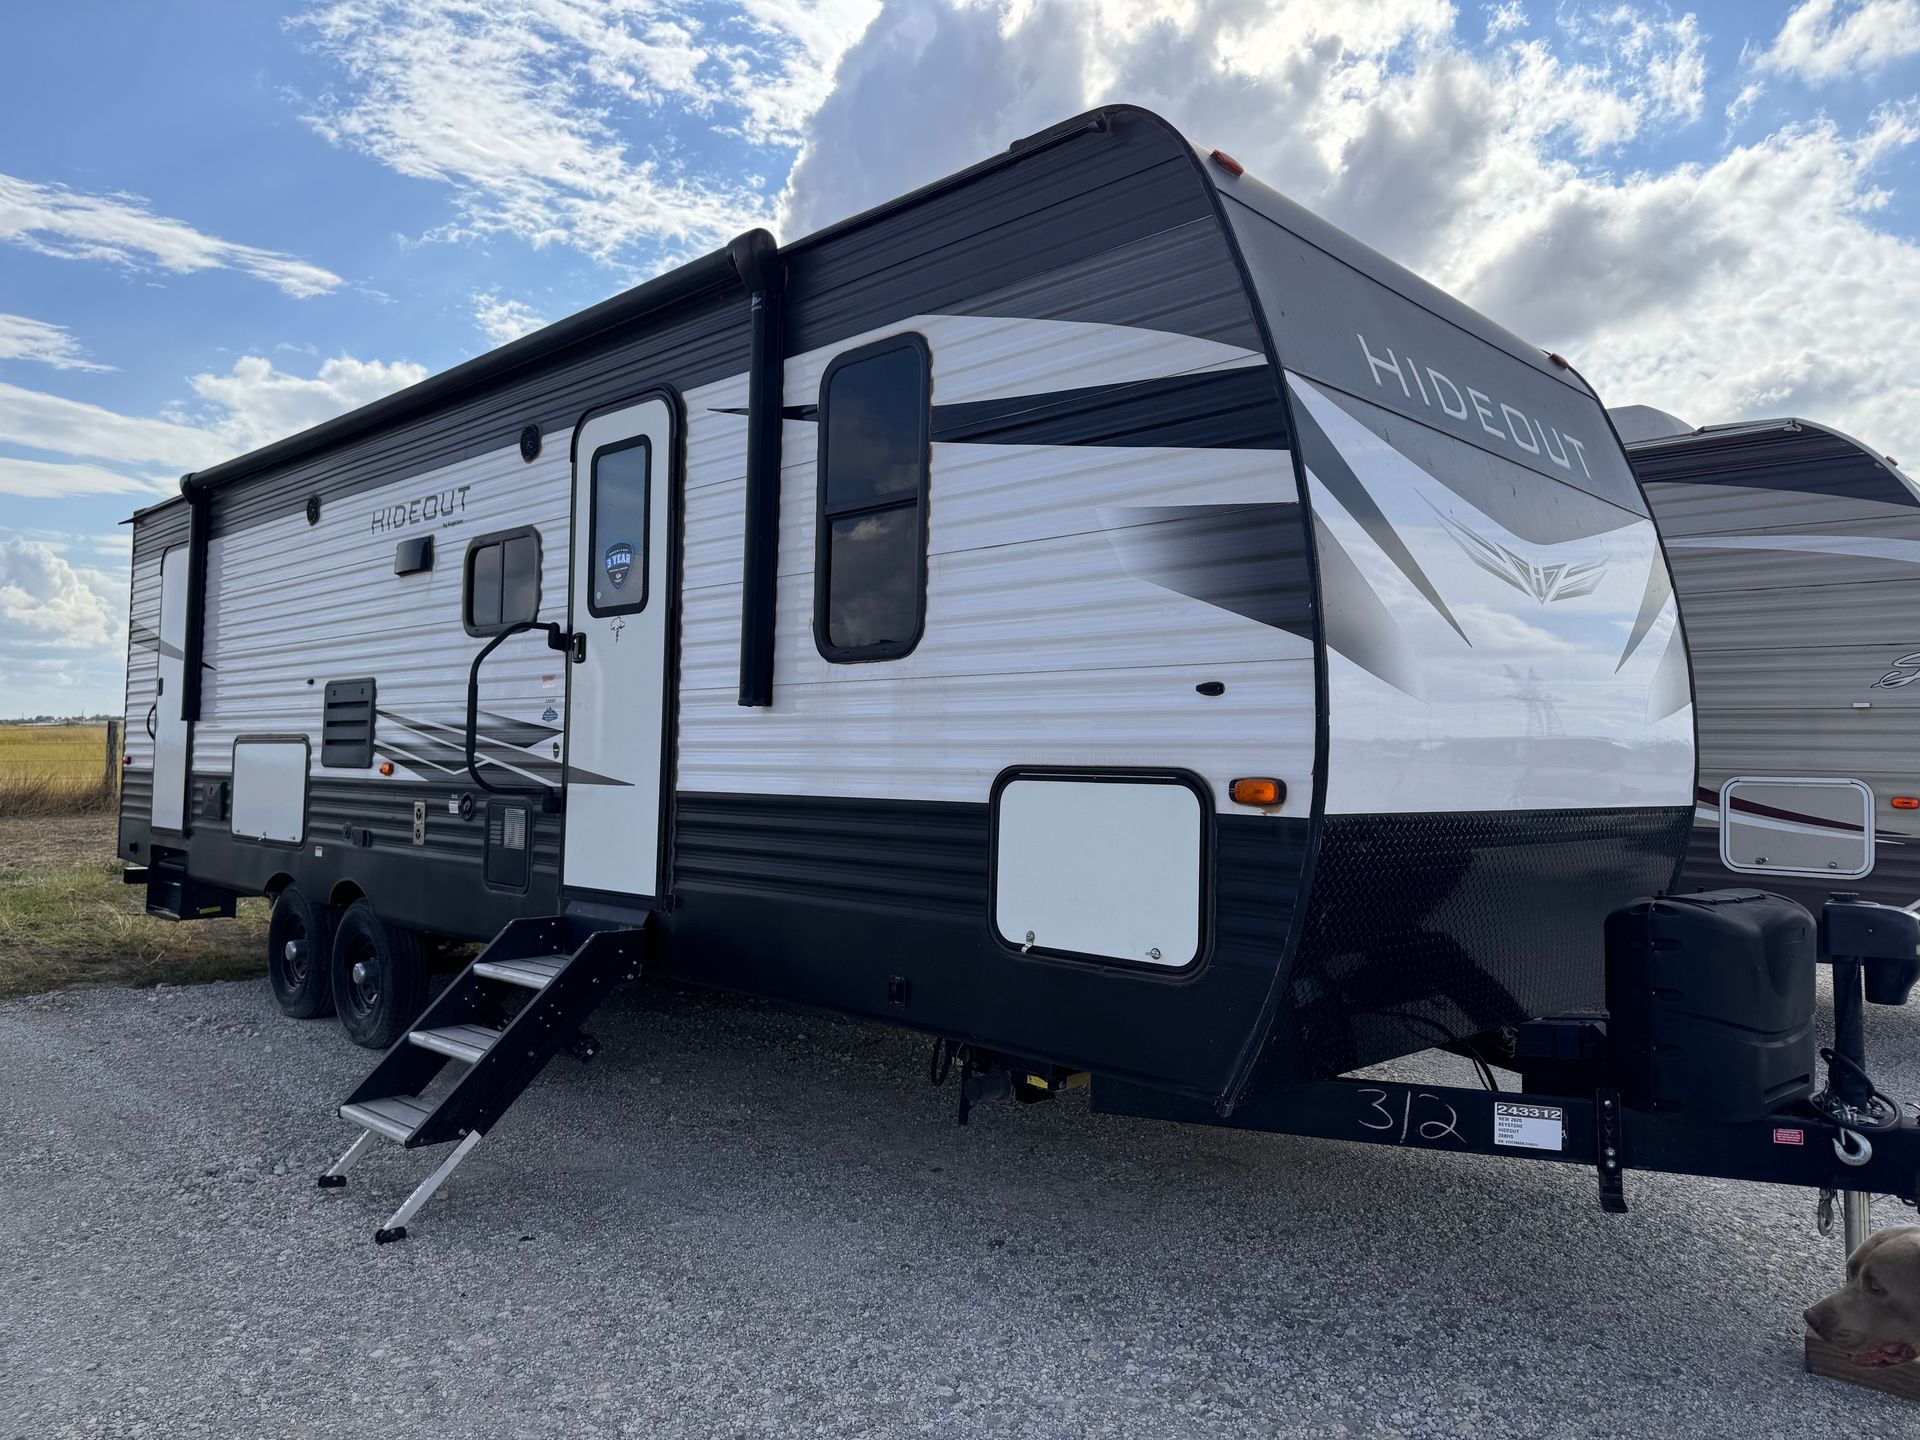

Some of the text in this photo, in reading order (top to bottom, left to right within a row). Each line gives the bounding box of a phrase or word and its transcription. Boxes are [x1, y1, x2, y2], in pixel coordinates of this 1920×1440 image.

[1357, 333, 1592, 480] HIDEOUT
[371, 485, 471, 534] HIDEOUT
[607, 554, 630, 568] 3 YEAR
[1357, 1089, 1467, 1143] 312
[1497, 1105, 1560, 1119] 243312
